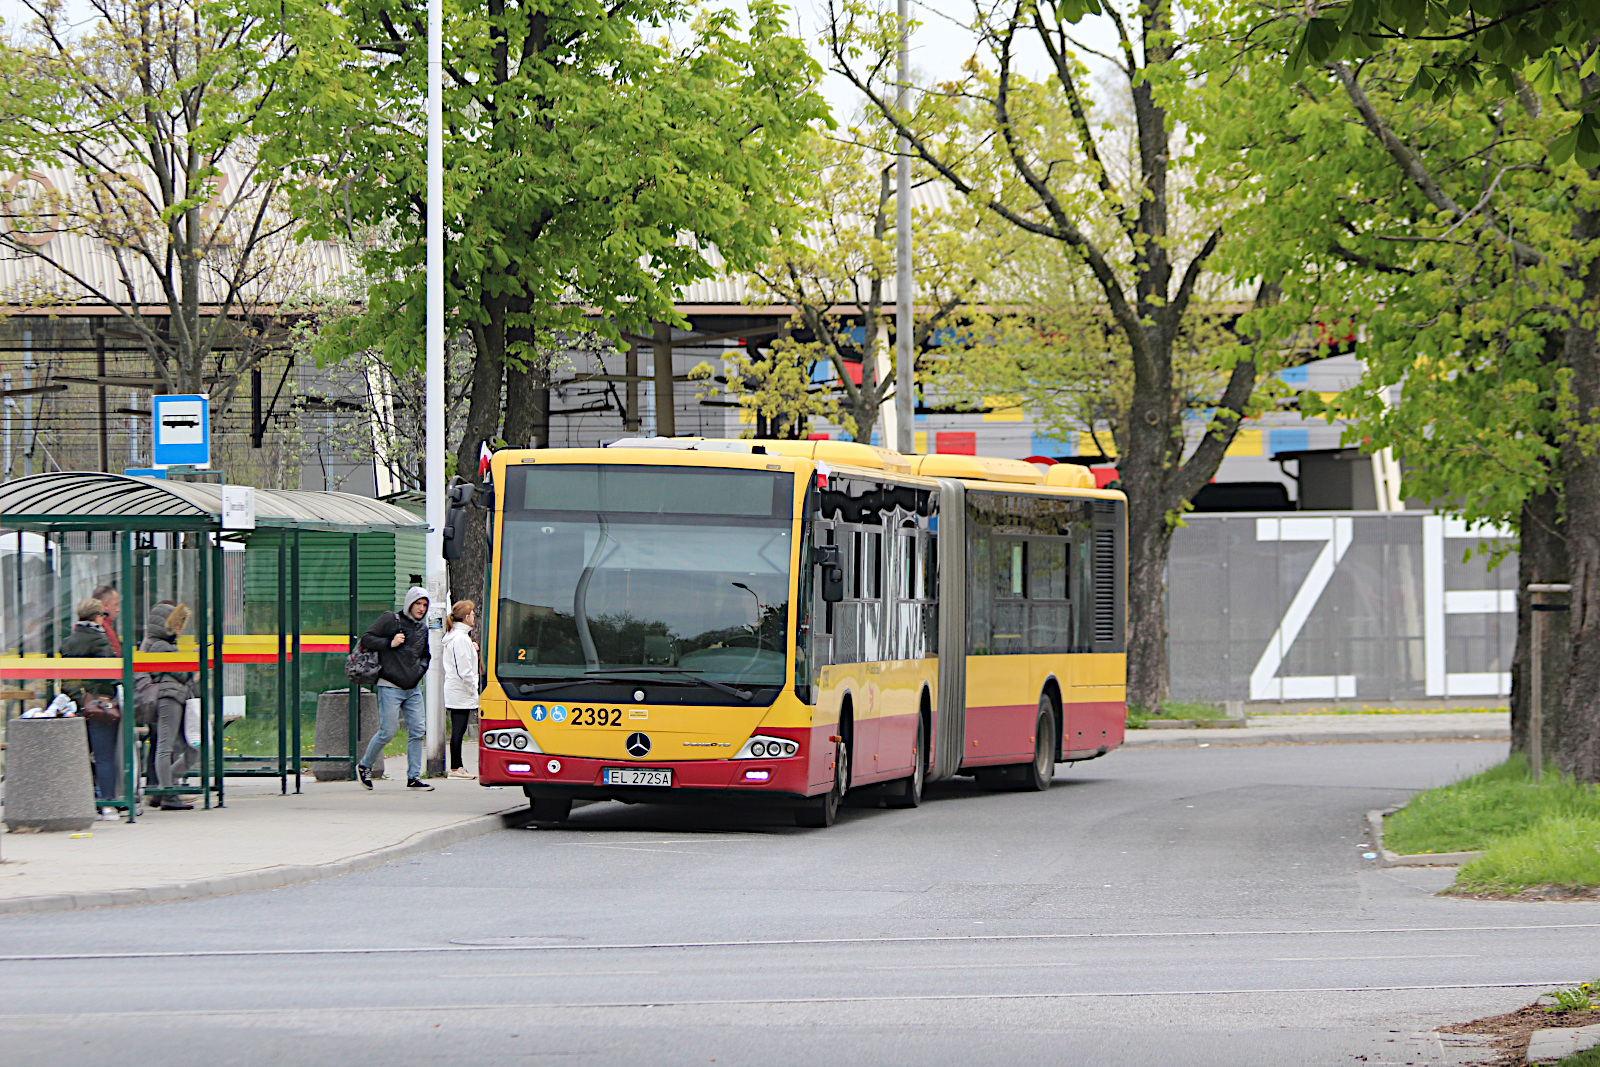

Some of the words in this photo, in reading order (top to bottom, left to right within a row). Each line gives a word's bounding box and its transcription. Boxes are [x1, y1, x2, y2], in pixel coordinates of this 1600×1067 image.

[517, 648, 527, 660] 2
[571, 707, 622, 727] 2392
[611, 771, 628, 784] EL
[632, 772, 669, 785] 272SA
